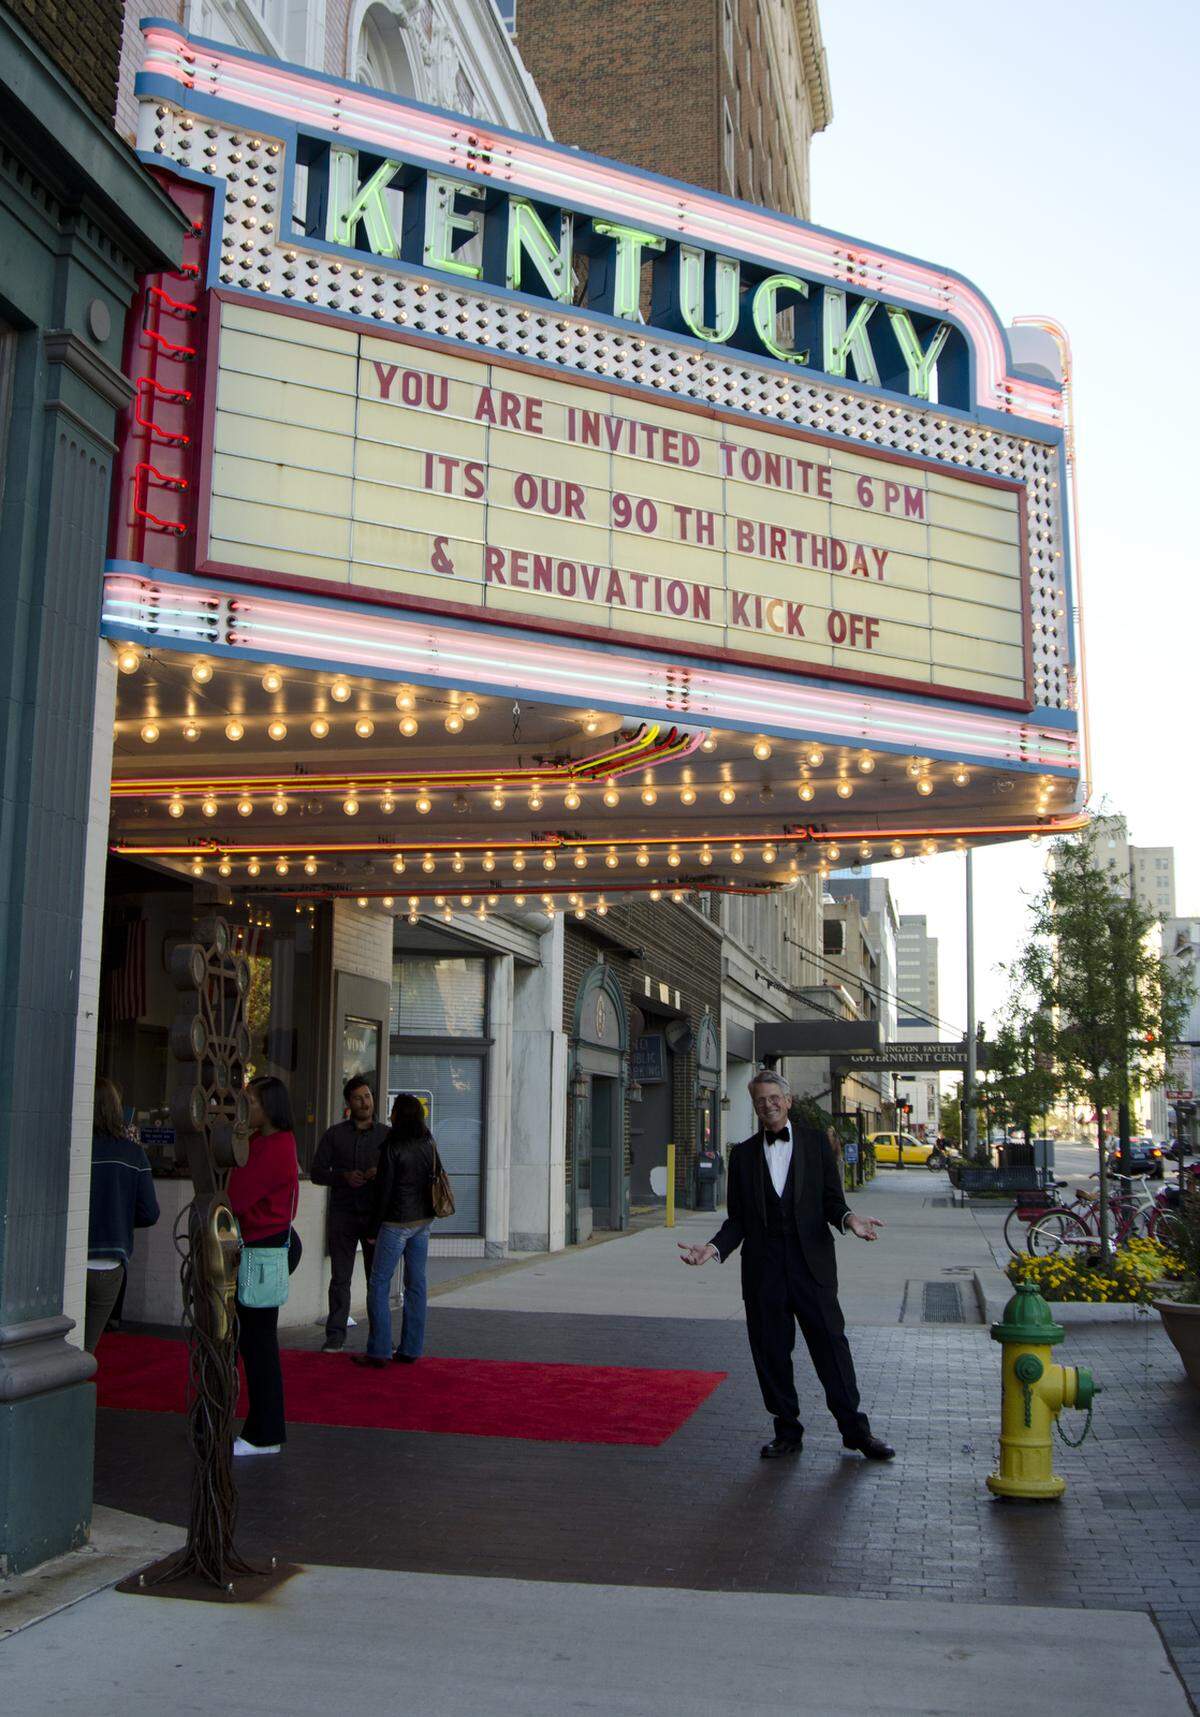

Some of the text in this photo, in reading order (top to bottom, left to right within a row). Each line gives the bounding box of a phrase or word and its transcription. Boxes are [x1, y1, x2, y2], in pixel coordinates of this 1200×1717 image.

[326, 145, 953, 401] KENTUCKY
[373, 361, 449, 412] YOU
[475, 386, 544, 434] ARE
[567, 407, 701, 468] INVITED
[720, 443, 833, 499] TONITE
[425, 452, 889, 582] ITS OUR 90 TH BIRTHDAY
[431, 535, 880, 649] & RENOVATION KICK OFF
[850, 1053, 968, 1063] GOVERNMENT CENT
[886, 1045, 919, 1053] INGTON
